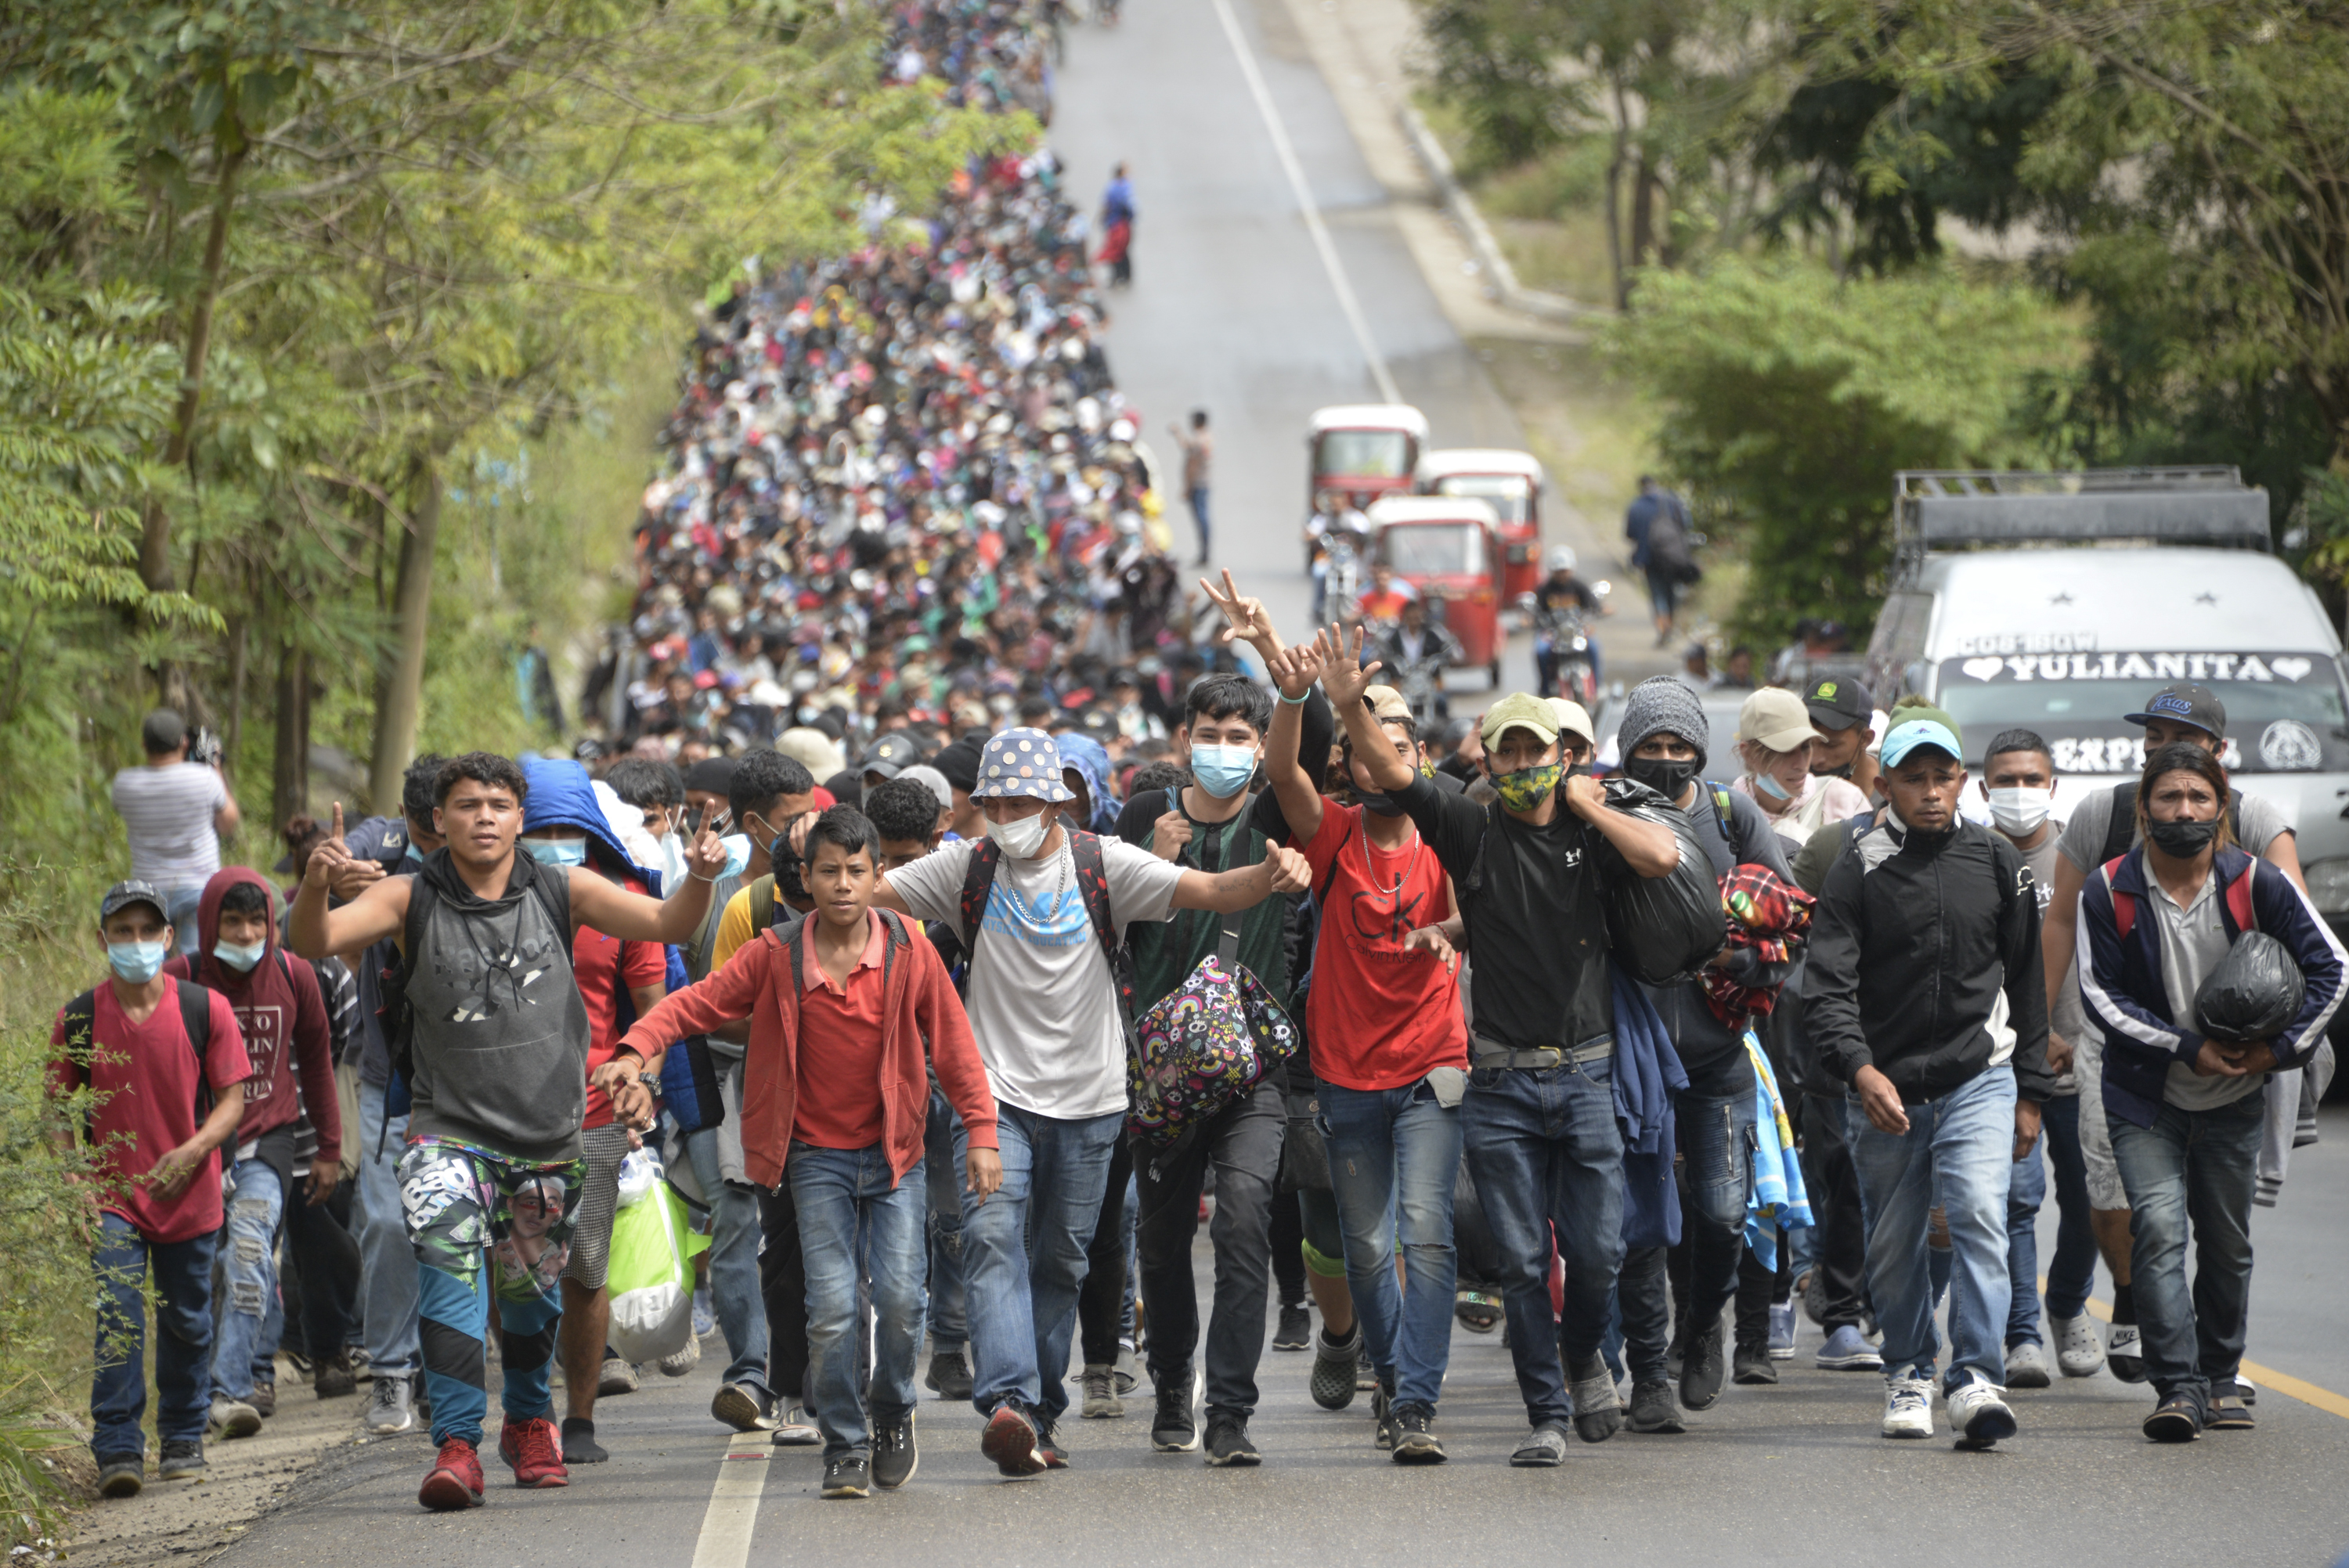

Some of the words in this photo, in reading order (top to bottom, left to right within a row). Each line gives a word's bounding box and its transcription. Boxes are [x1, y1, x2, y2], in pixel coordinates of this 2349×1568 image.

[2005, 652, 2273, 681] YULIANITA
[2150, 692, 2192, 714] Texas
[982, 917, 1024, 940] HYSICAL
[1028, 932, 1087, 947] EDUCATION
[435, 928, 557, 975] Reebok
[1345, 934, 1389, 961] Calvin
[1393, 947, 1426, 964] Klein
[400, 1159, 472, 1213] Bad
[1467, 1293, 1488, 1303] LOVE
[2115, 1330, 2136, 1342] NIKE
